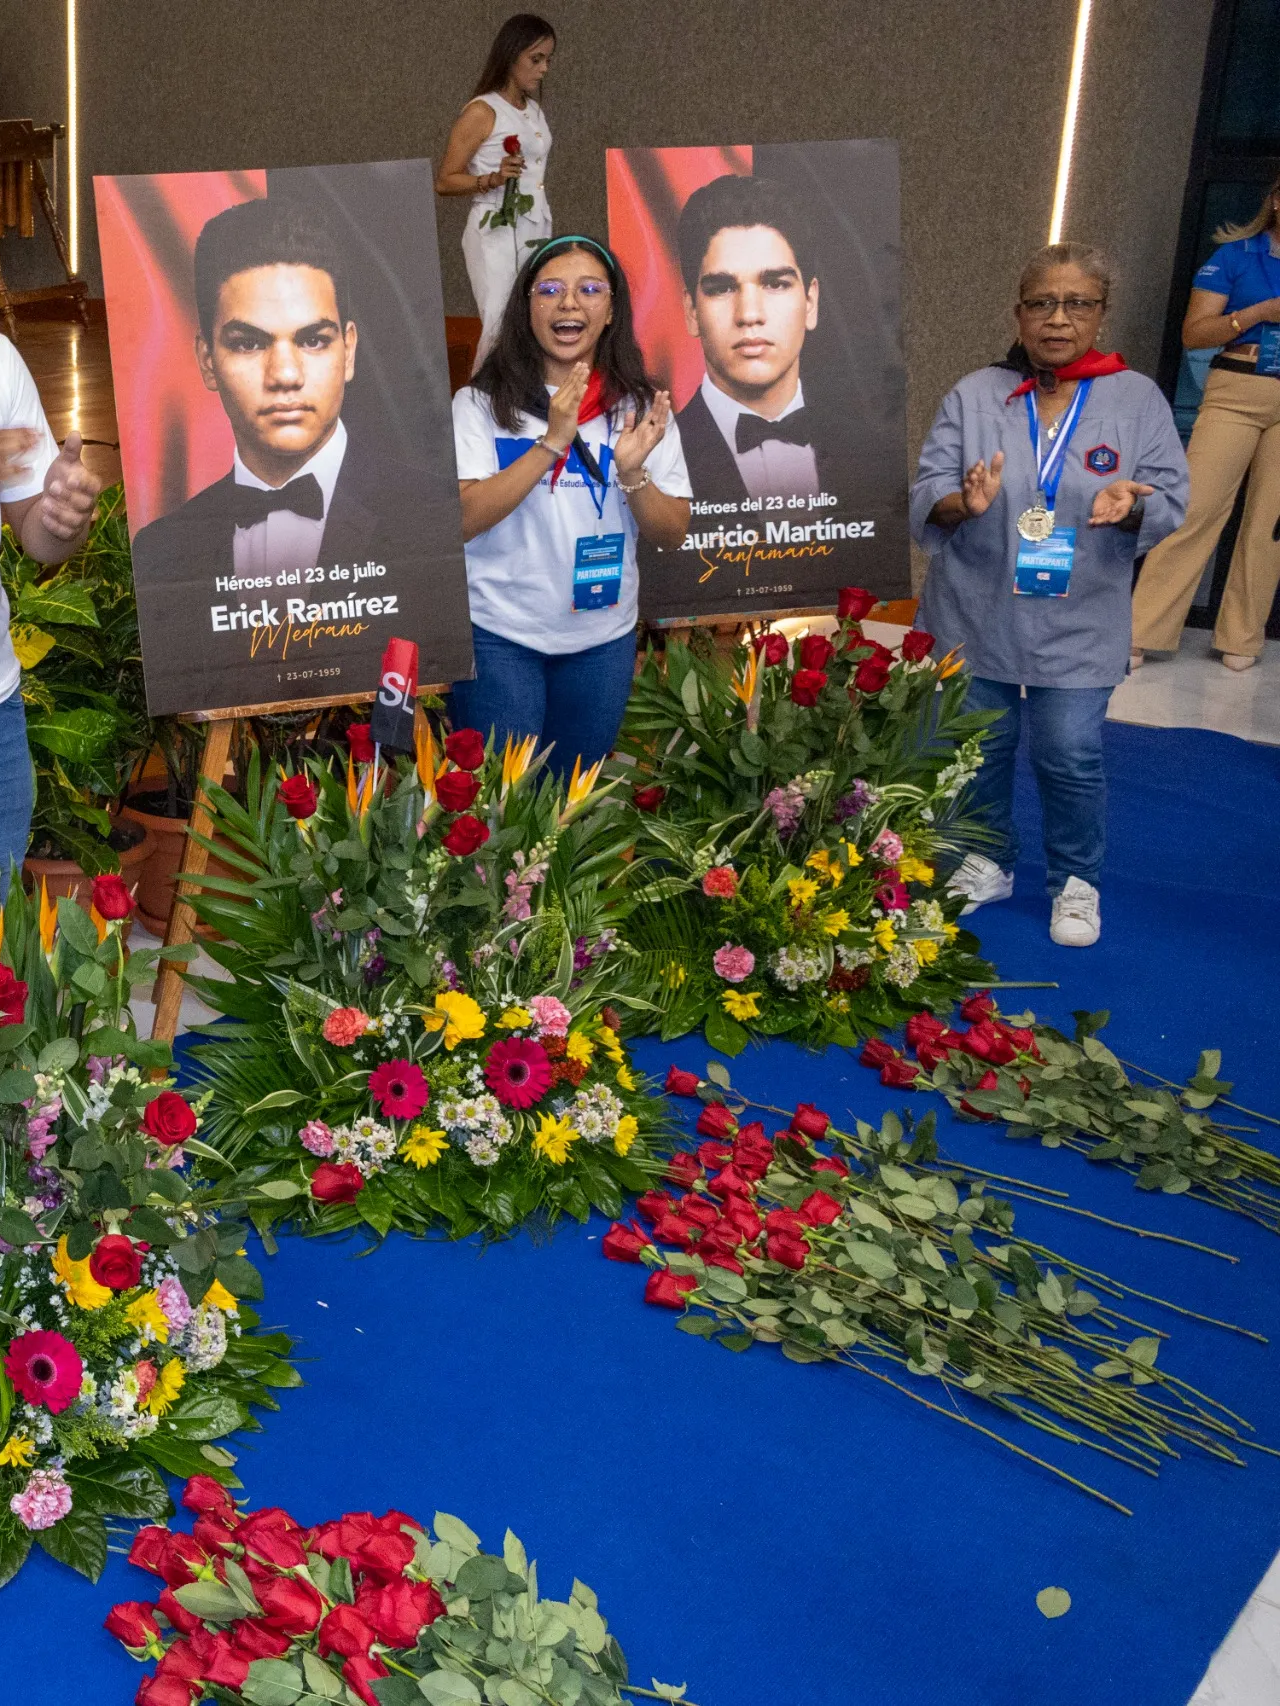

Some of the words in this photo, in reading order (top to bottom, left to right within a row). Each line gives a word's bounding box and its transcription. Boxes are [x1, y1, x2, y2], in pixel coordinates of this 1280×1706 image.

[689, 500, 738, 516] Héroes
[741, 495, 762, 513] del
[766, 496, 784, 510] 23
[787, 494, 804, 509] de
[808, 492, 838, 511] julio
[658, 524, 759, 552] auricio
[765, 517, 875, 544] Martínez
[698, 531, 834, 584] Santamaría
[1021, 556, 1069, 568] PARTICIPANTE
[215, 575, 272, 592] Héroes
[276, 568, 300, 587] del
[304, 567, 324, 584] 23
[328, 564, 350, 580] de
[353, 562, 387, 583] julio
[576, 566, 620, 580] PARTICIPANTE
[745, 584, 792, 595] 23-07-1959
[210, 599, 281, 632] Erick
[286, 591, 399, 624] Ramírez
[250, 608, 370, 660] Medrano
[286, 667, 342, 681] 23-07-1959
